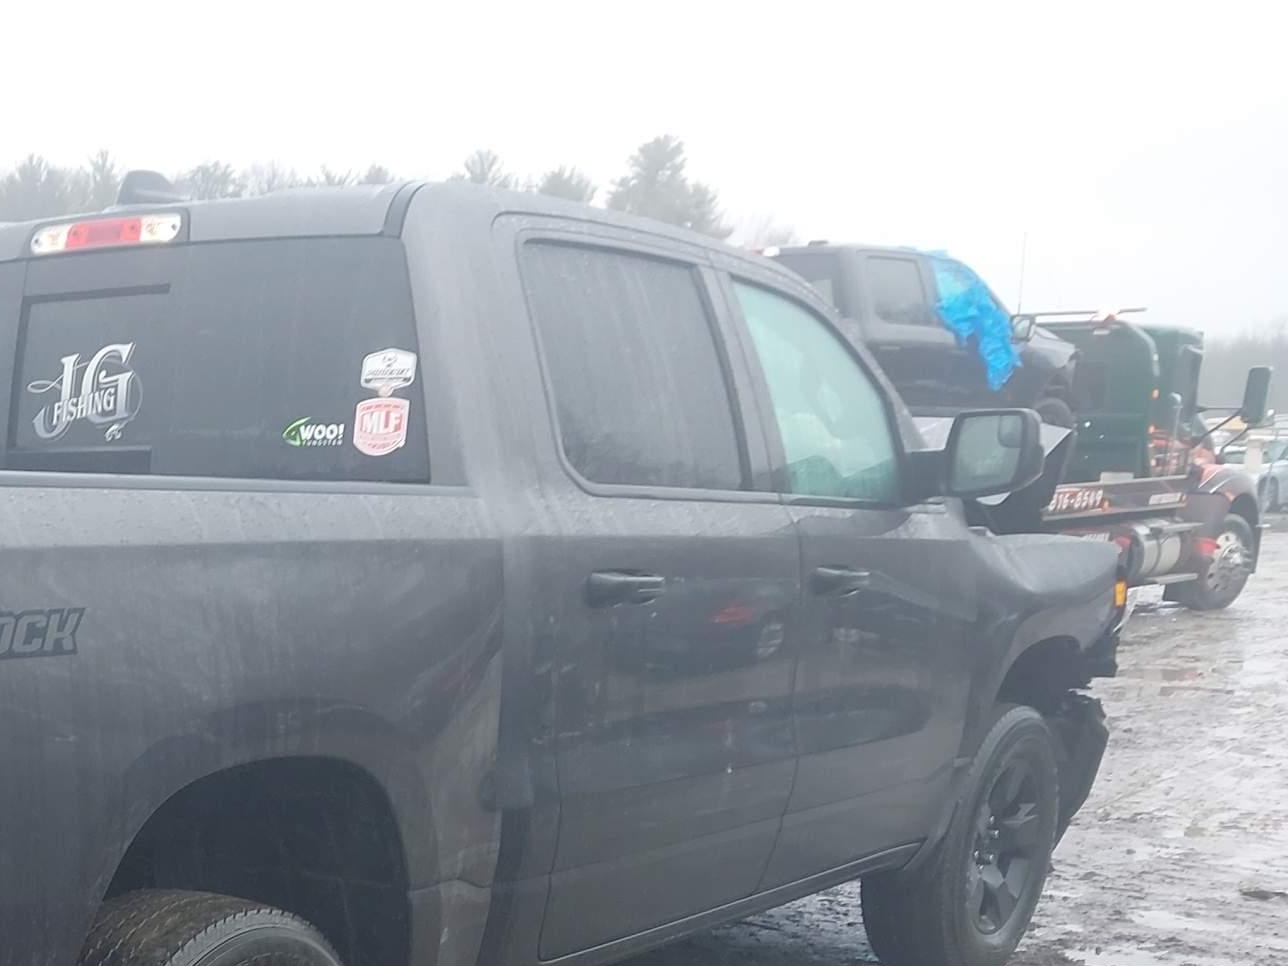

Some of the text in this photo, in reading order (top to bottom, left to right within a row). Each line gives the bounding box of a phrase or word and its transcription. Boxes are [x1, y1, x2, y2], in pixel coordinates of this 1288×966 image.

[53, 387, 116, 426] FISHING
[299, 423, 345, 441] WOO!
[360, 409, 403, 434] MLF
